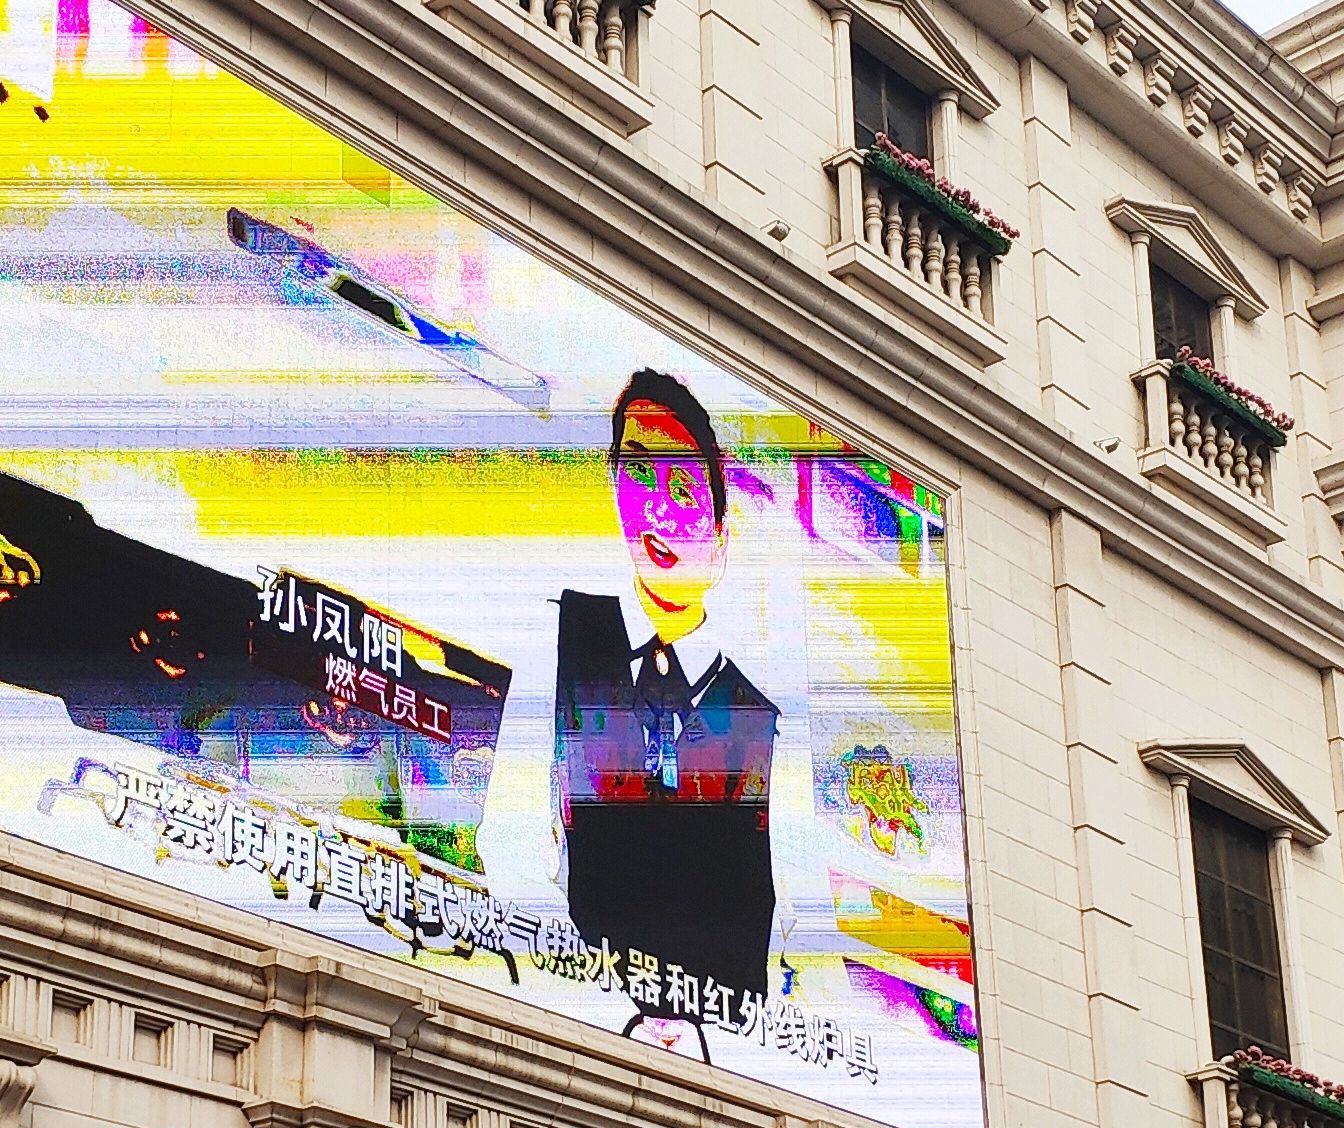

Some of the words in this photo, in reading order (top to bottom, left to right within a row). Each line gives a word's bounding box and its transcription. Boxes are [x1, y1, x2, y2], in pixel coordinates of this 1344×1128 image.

[256, 565, 403, 678] 孙凤阳
[325, 652, 451, 739] 燃气员工
[113, 763, 878, 1084] 严禁使用直排式燃气热水器和红外线炉具
